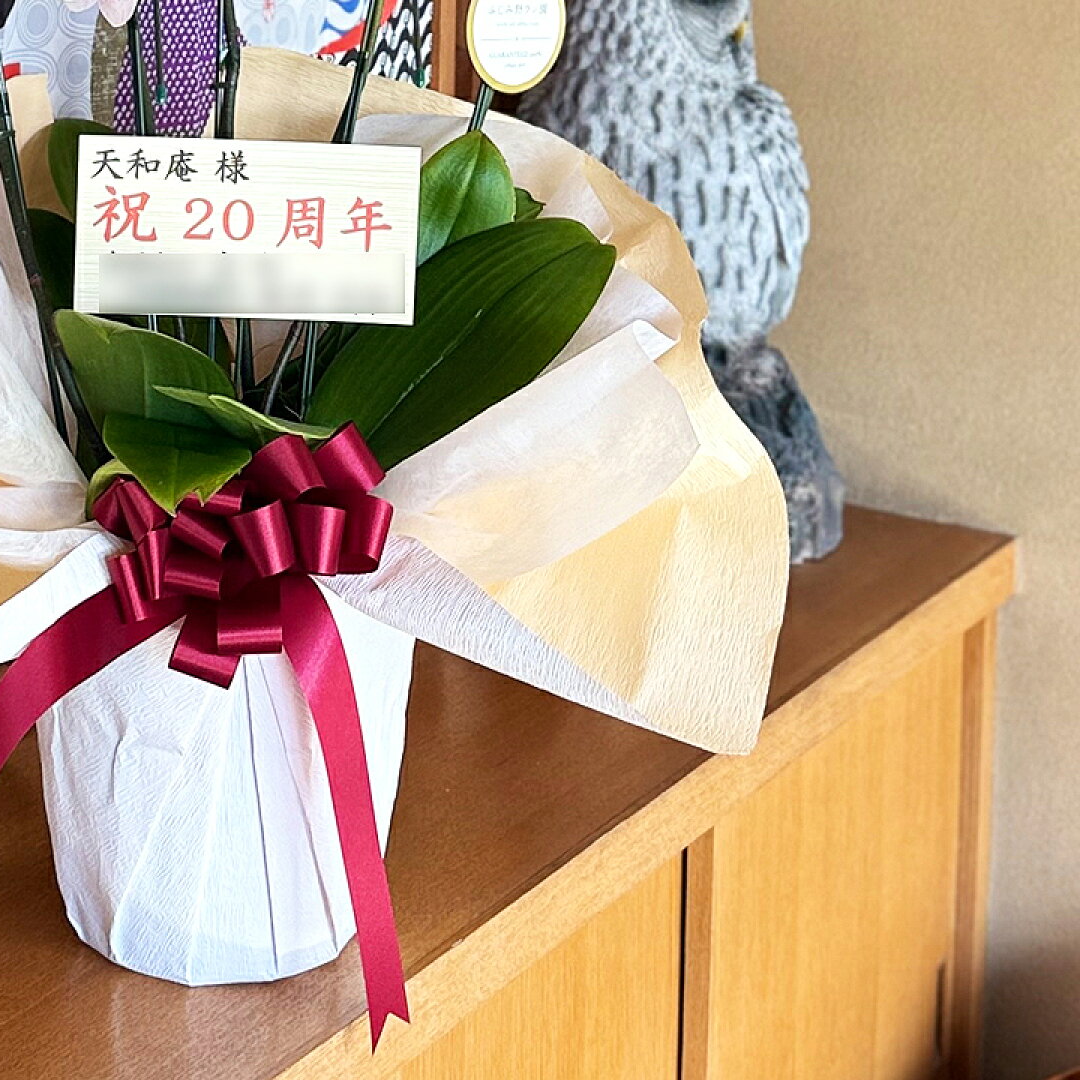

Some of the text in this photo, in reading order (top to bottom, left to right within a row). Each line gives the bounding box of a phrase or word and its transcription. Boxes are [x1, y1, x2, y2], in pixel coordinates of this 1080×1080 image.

[91, 149, 250, 184] 天和庵 様
[92, 185, 393, 252] 祝 20 周年
